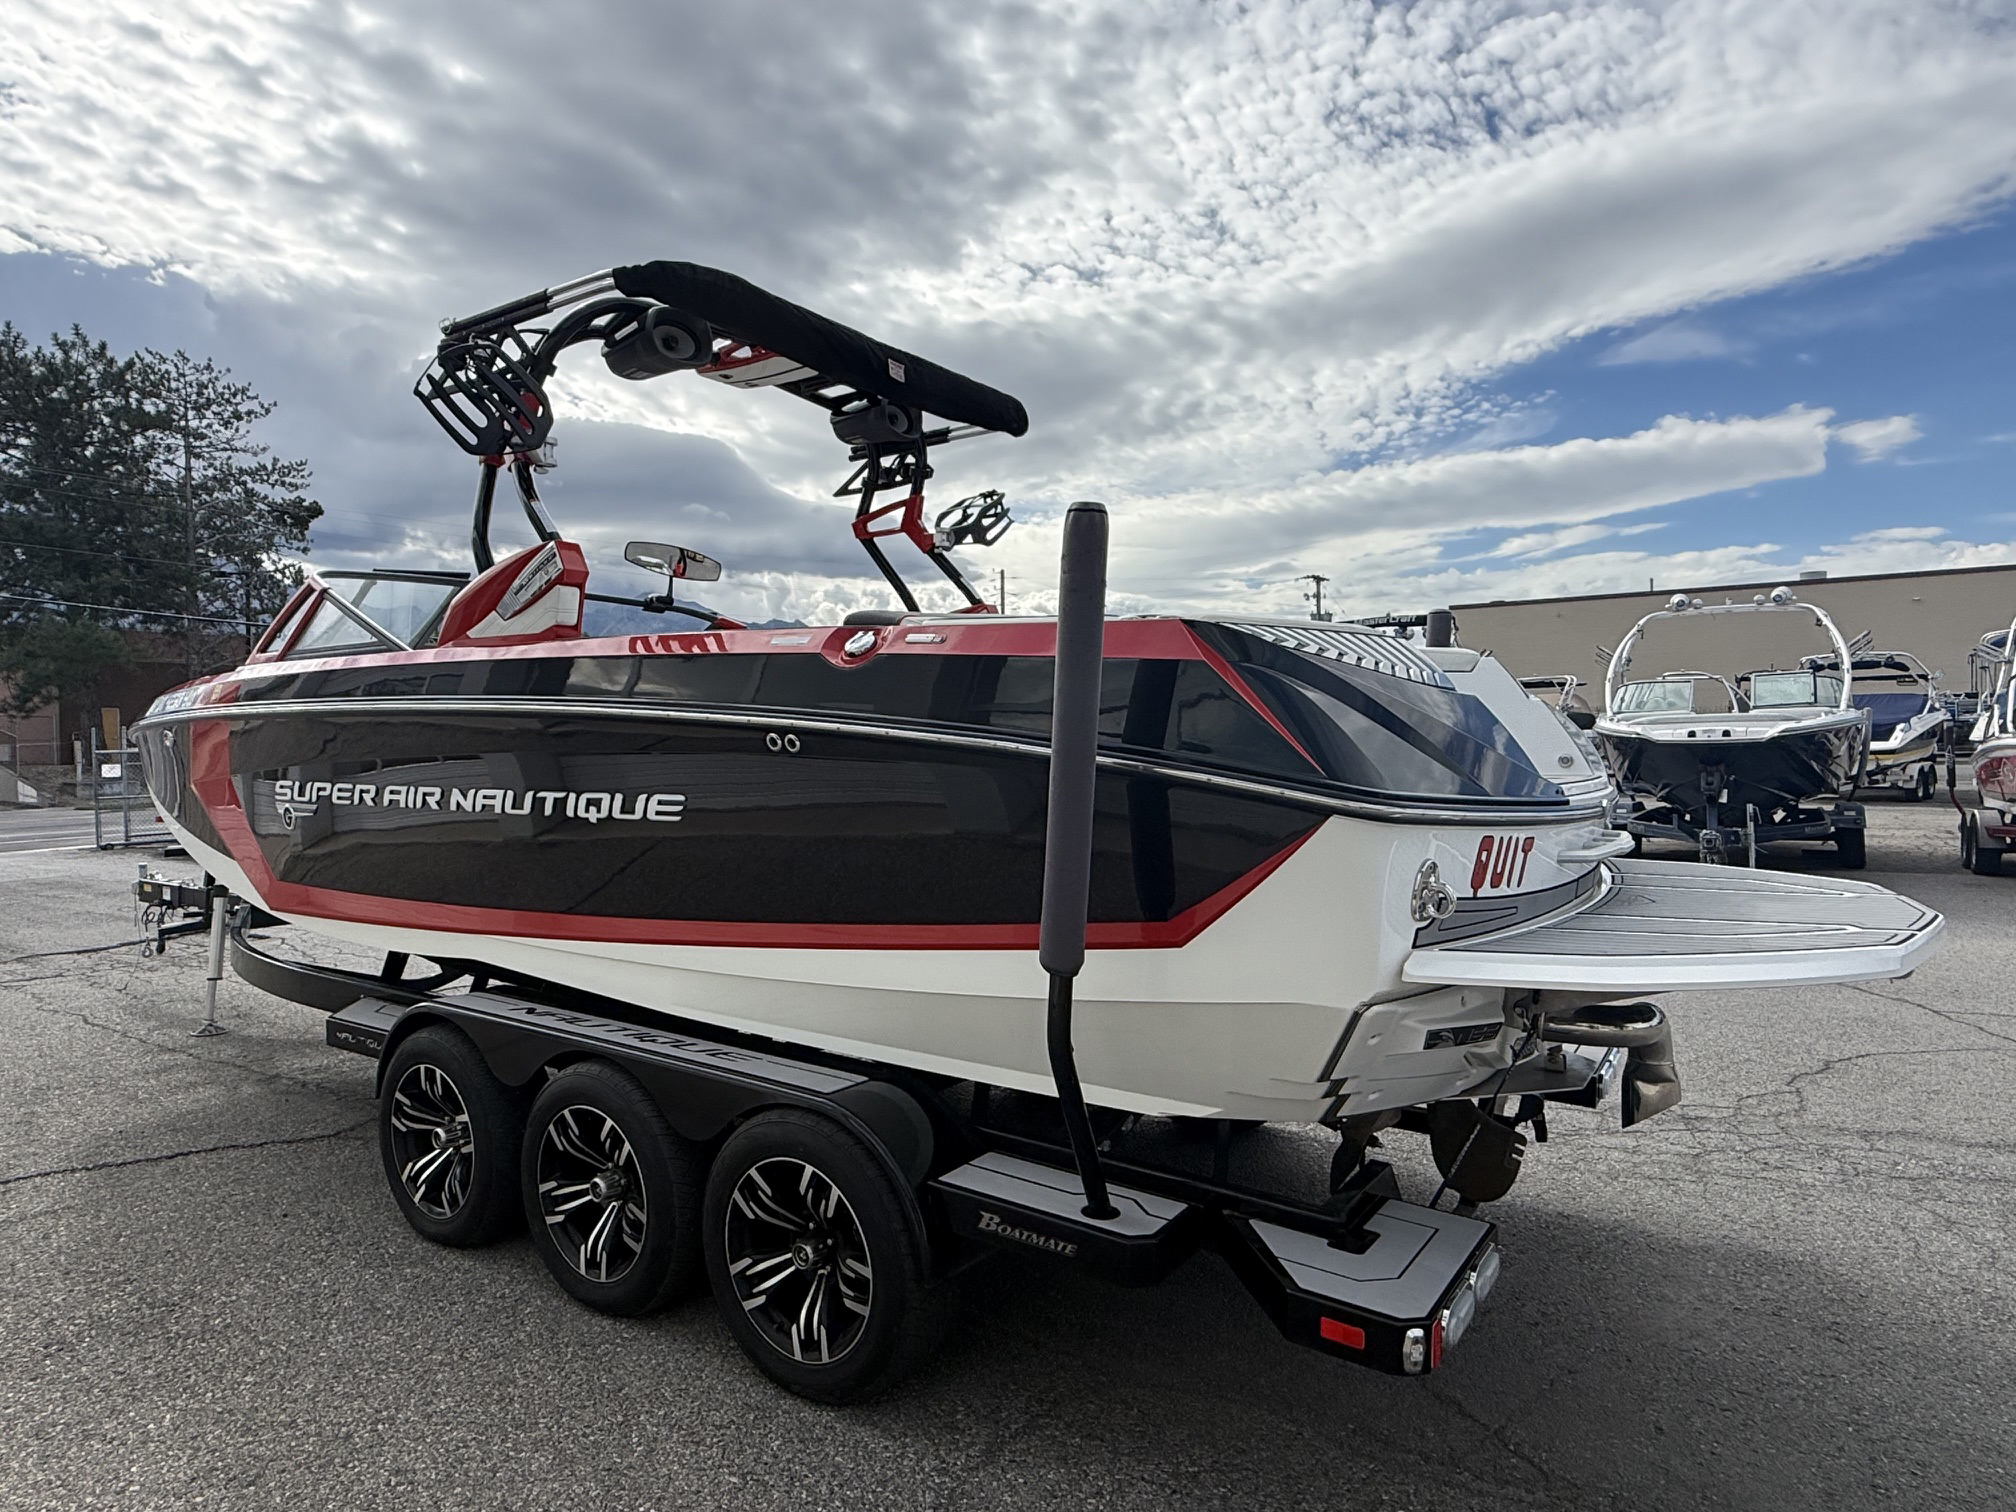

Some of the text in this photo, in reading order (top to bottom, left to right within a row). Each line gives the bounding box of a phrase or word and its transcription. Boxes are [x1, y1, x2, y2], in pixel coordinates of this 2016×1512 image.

[274, 780, 687, 824] SUPER AIR NAUTIQUE
[1470, 834, 1535, 898] QUIT
[509, 1006, 764, 1063] NAUTIQUE
